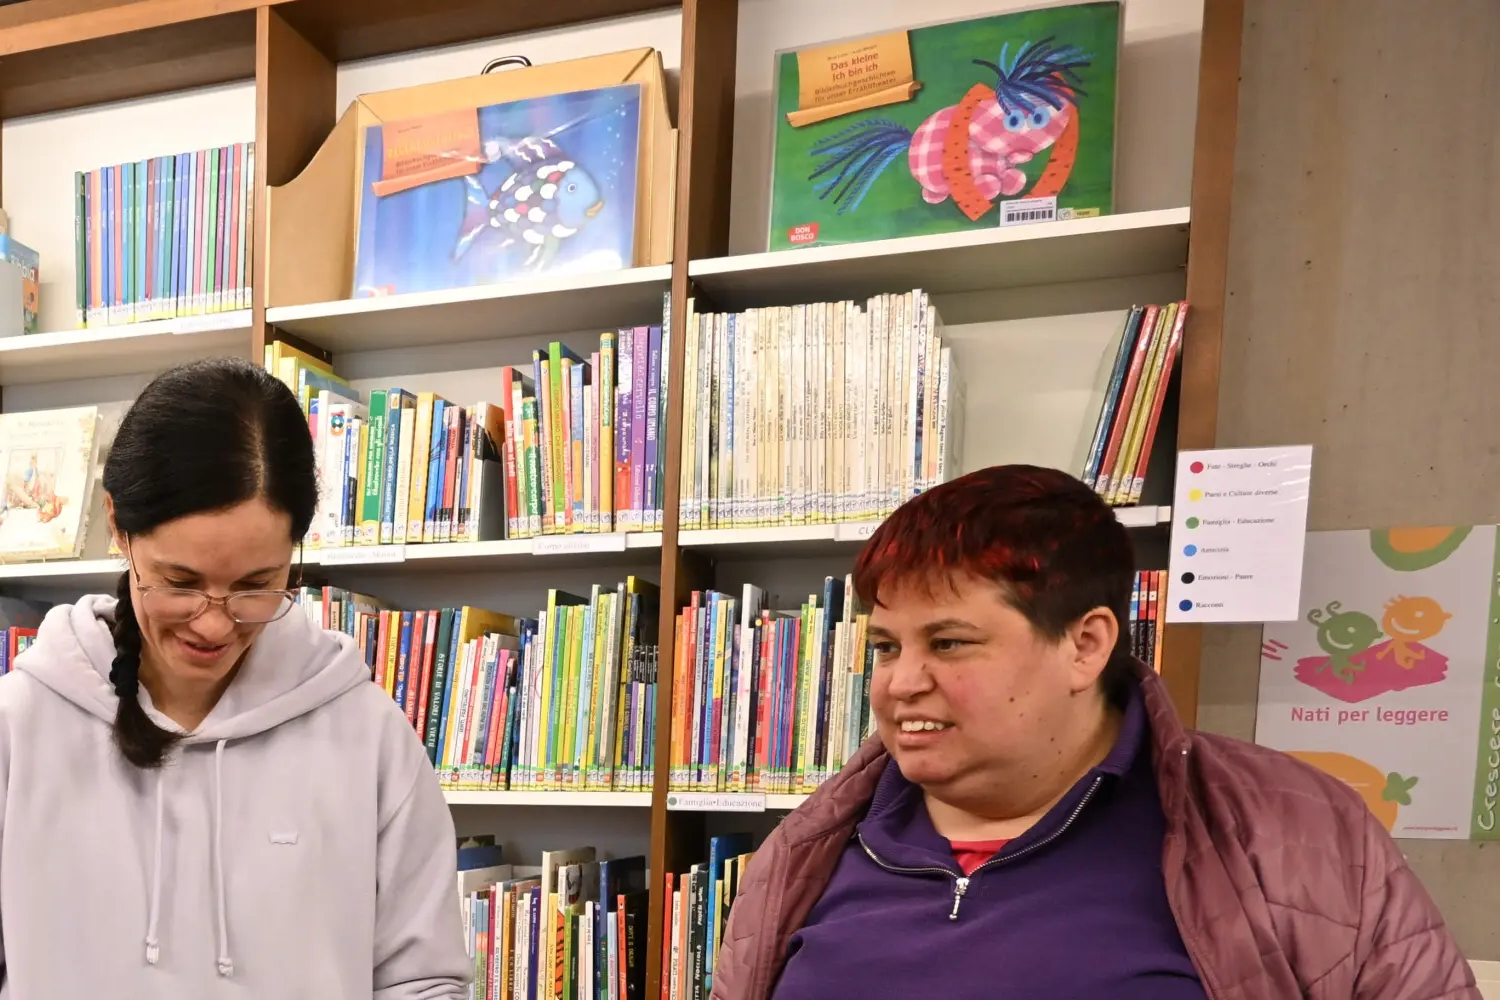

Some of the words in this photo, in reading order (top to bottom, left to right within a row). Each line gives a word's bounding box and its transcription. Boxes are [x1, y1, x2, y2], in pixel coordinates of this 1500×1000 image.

[831, 61, 848, 71] Das
[851, 52, 879, 65] kleine
[848, 67, 863, 76] bin
[795, 226, 810, 234] DON
[791, 233, 814, 242] BOSCO
[1237, 517, 1275, 525] Educazione
[1291, 706, 1330, 722] Nati
[1338, 708, 1370, 725] per
[1376, 706, 1449, 725] leggere
[1477, 707, 1500, 831] Crescere
[694, 944, 702, 980] NOCCIOLA
